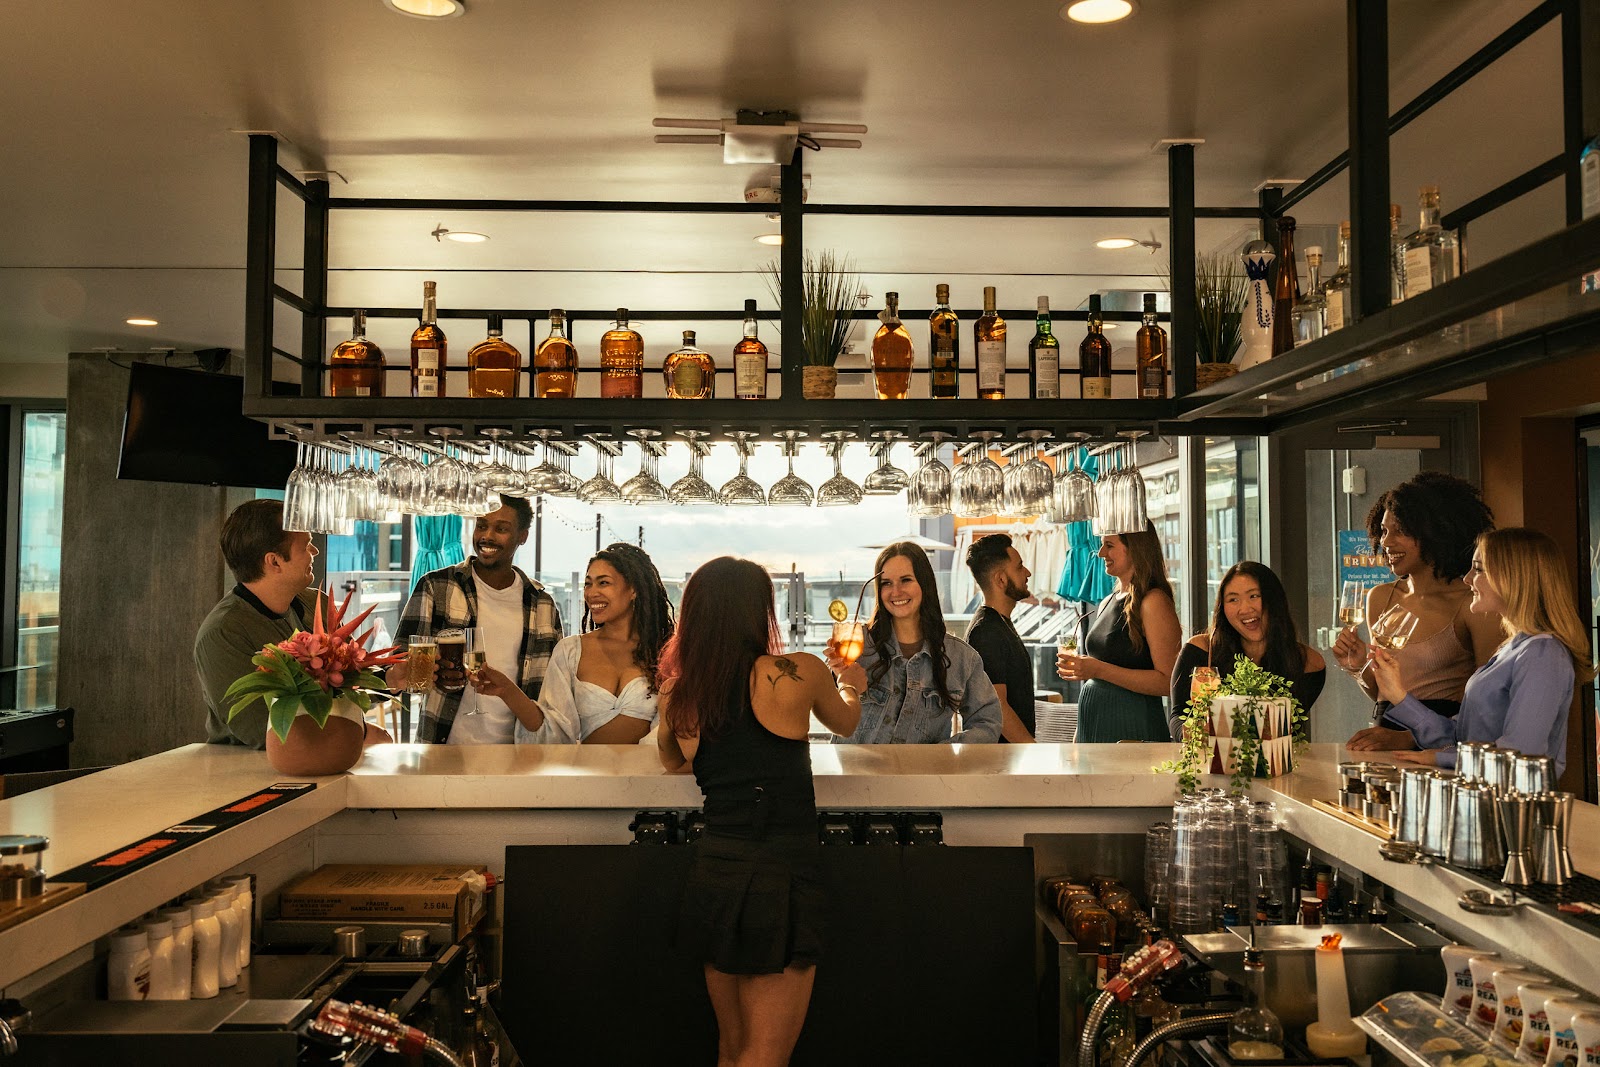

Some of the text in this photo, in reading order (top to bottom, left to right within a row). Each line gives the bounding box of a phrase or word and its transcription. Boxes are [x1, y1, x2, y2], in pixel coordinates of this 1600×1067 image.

[1343, 556, 1387, 566] TRIVI
[423, 902, 452, 910] 2.5 GAL.
[1456, 978, 1473, 987] RE
[1504, 1005, 1523, 1016] REA
[1530, 1020, 1550, 1031] REA
[1556, 1038, 1578, 1050] REA
[1586, 1054, 1600, 1064] RE
